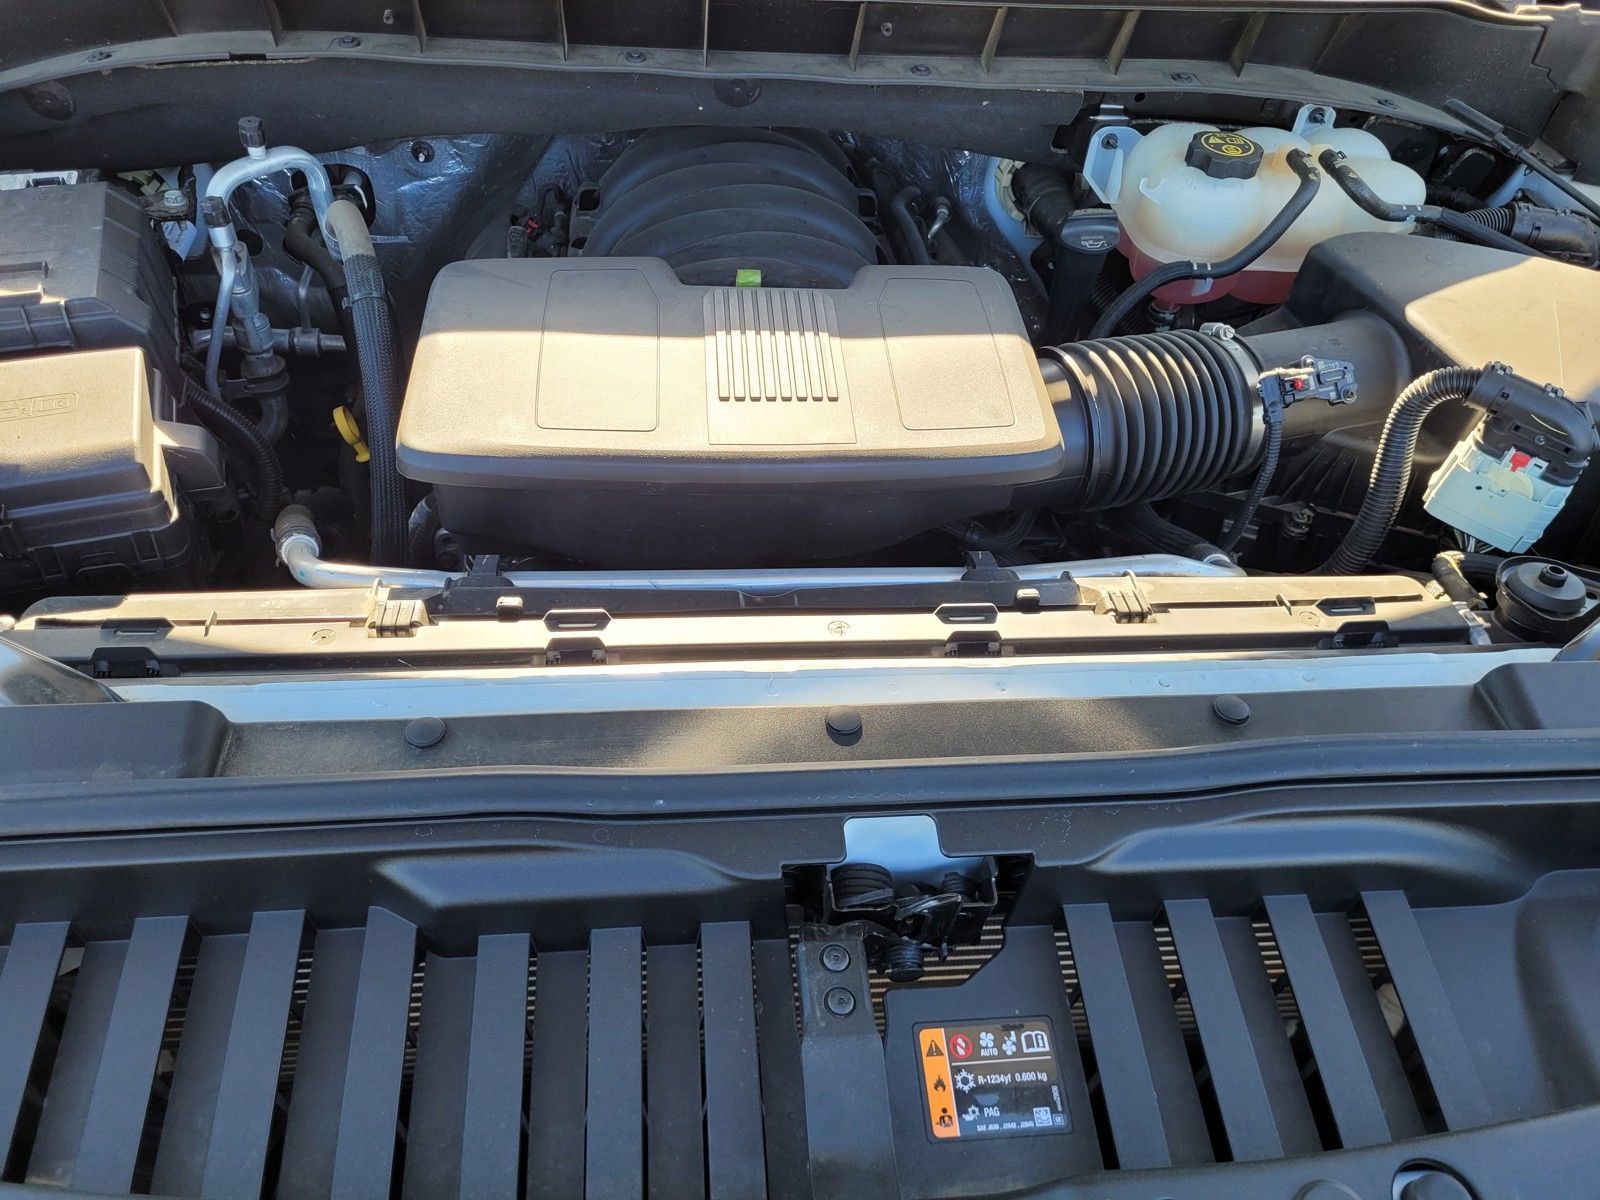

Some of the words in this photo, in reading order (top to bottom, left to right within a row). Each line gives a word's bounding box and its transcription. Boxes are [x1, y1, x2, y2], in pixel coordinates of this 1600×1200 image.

[980, 1048, 998, 1056] AUTO
[978, 1073, 1011, 1085] R-1234yf
[1015, 1072, 1036, 1082] 0.600
[1037, 1071, 1047, 1082] kg
[984, 1107, 1000, 1117] PAG
